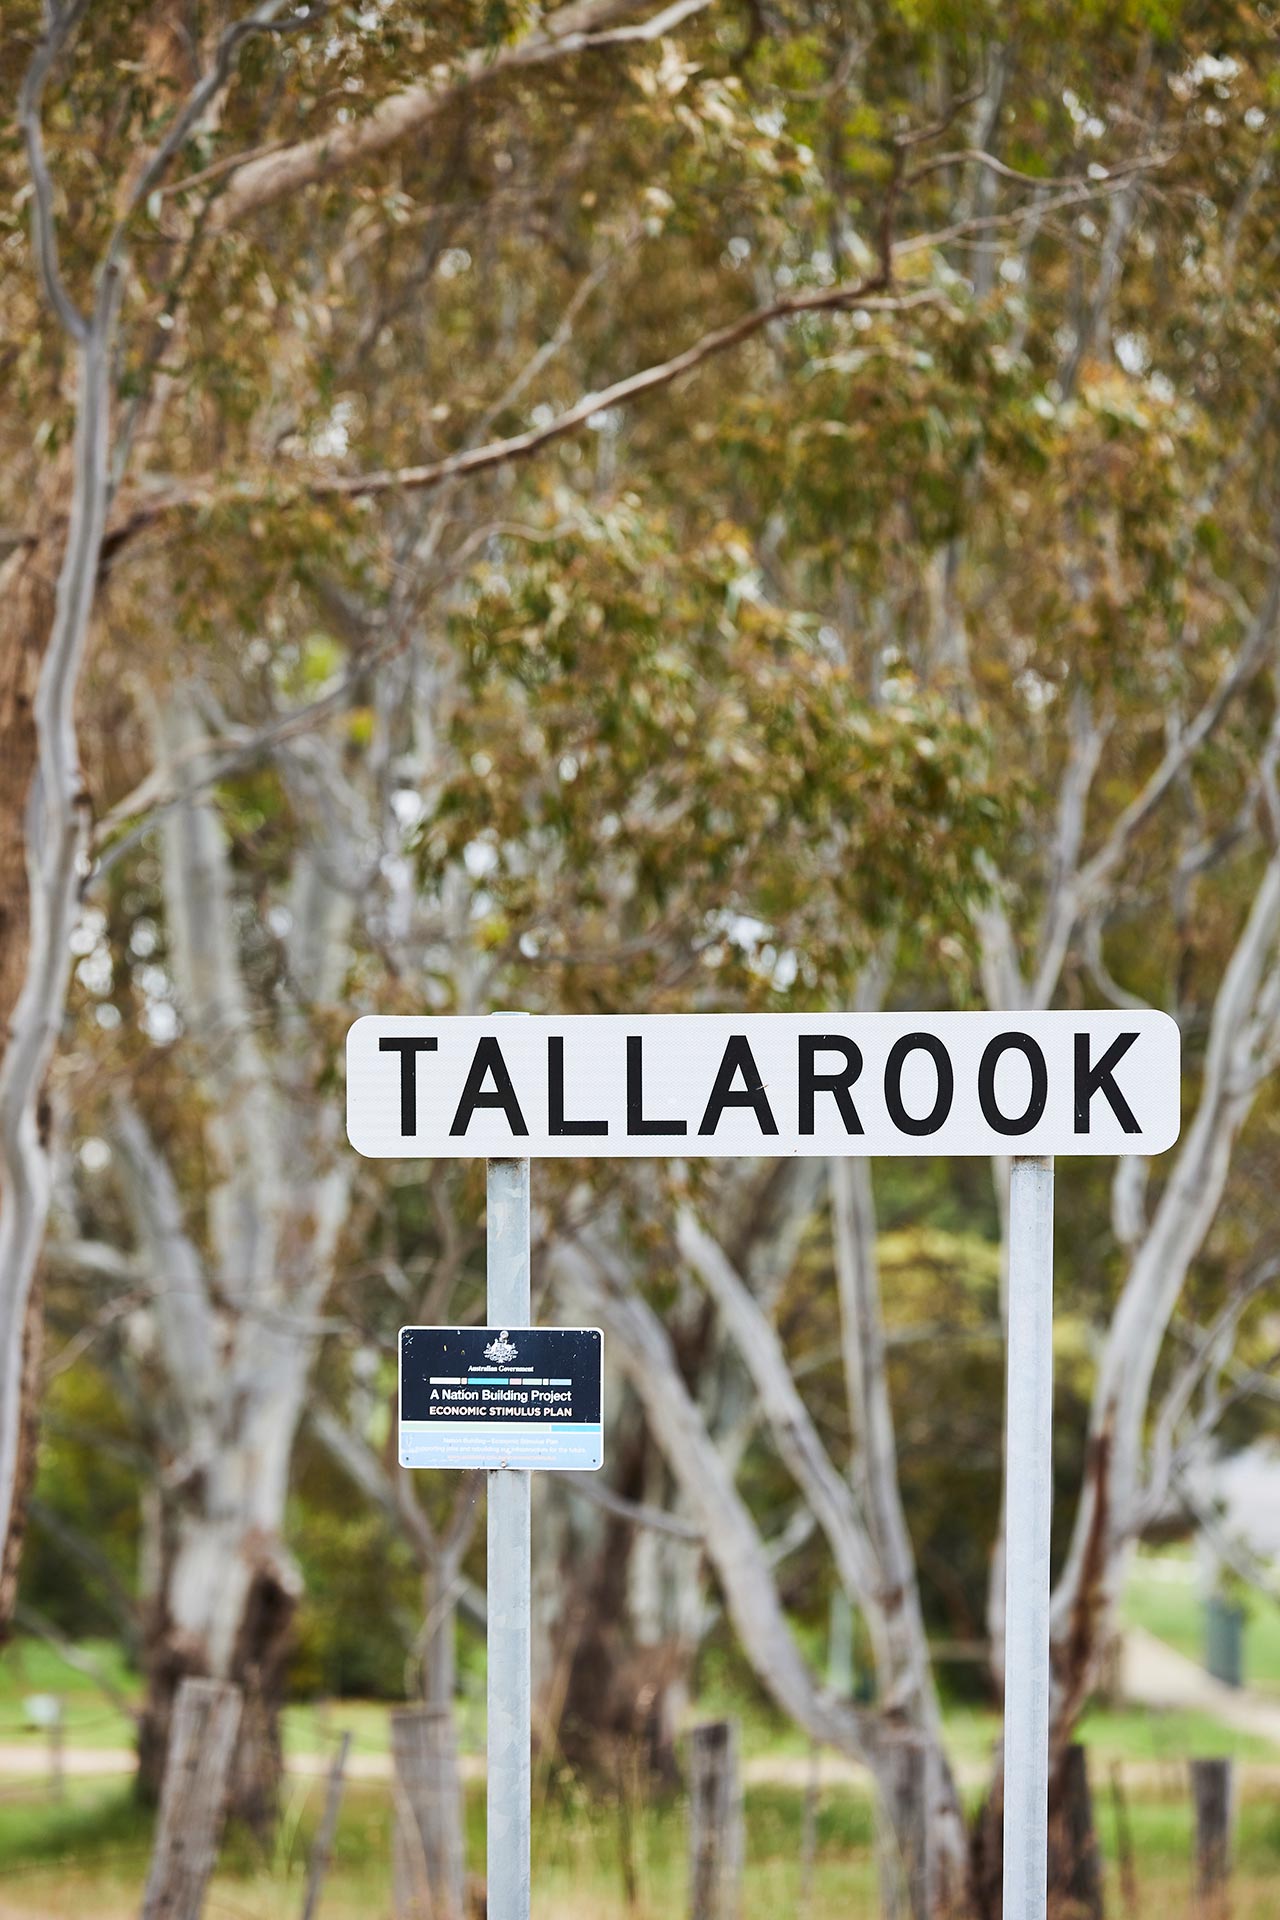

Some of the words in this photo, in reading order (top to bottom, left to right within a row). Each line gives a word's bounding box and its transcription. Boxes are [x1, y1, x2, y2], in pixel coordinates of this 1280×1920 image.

[379, 1032, 1142, 1136] TALLAROOK
[468, 1365, 498, 1373] Australian
[430, 1389, 439, 1400] A
[442, 1389, 479, 1400] Nation
[482, 1389, 528, 1403] Building
[531, 1390, 572, 1403] Project
[429, 1406, 487, 1416] ECONOMIC
[489, 1406, 541, 1416] STIMULUS
[544, 1407, 572, 1417] PLAN
